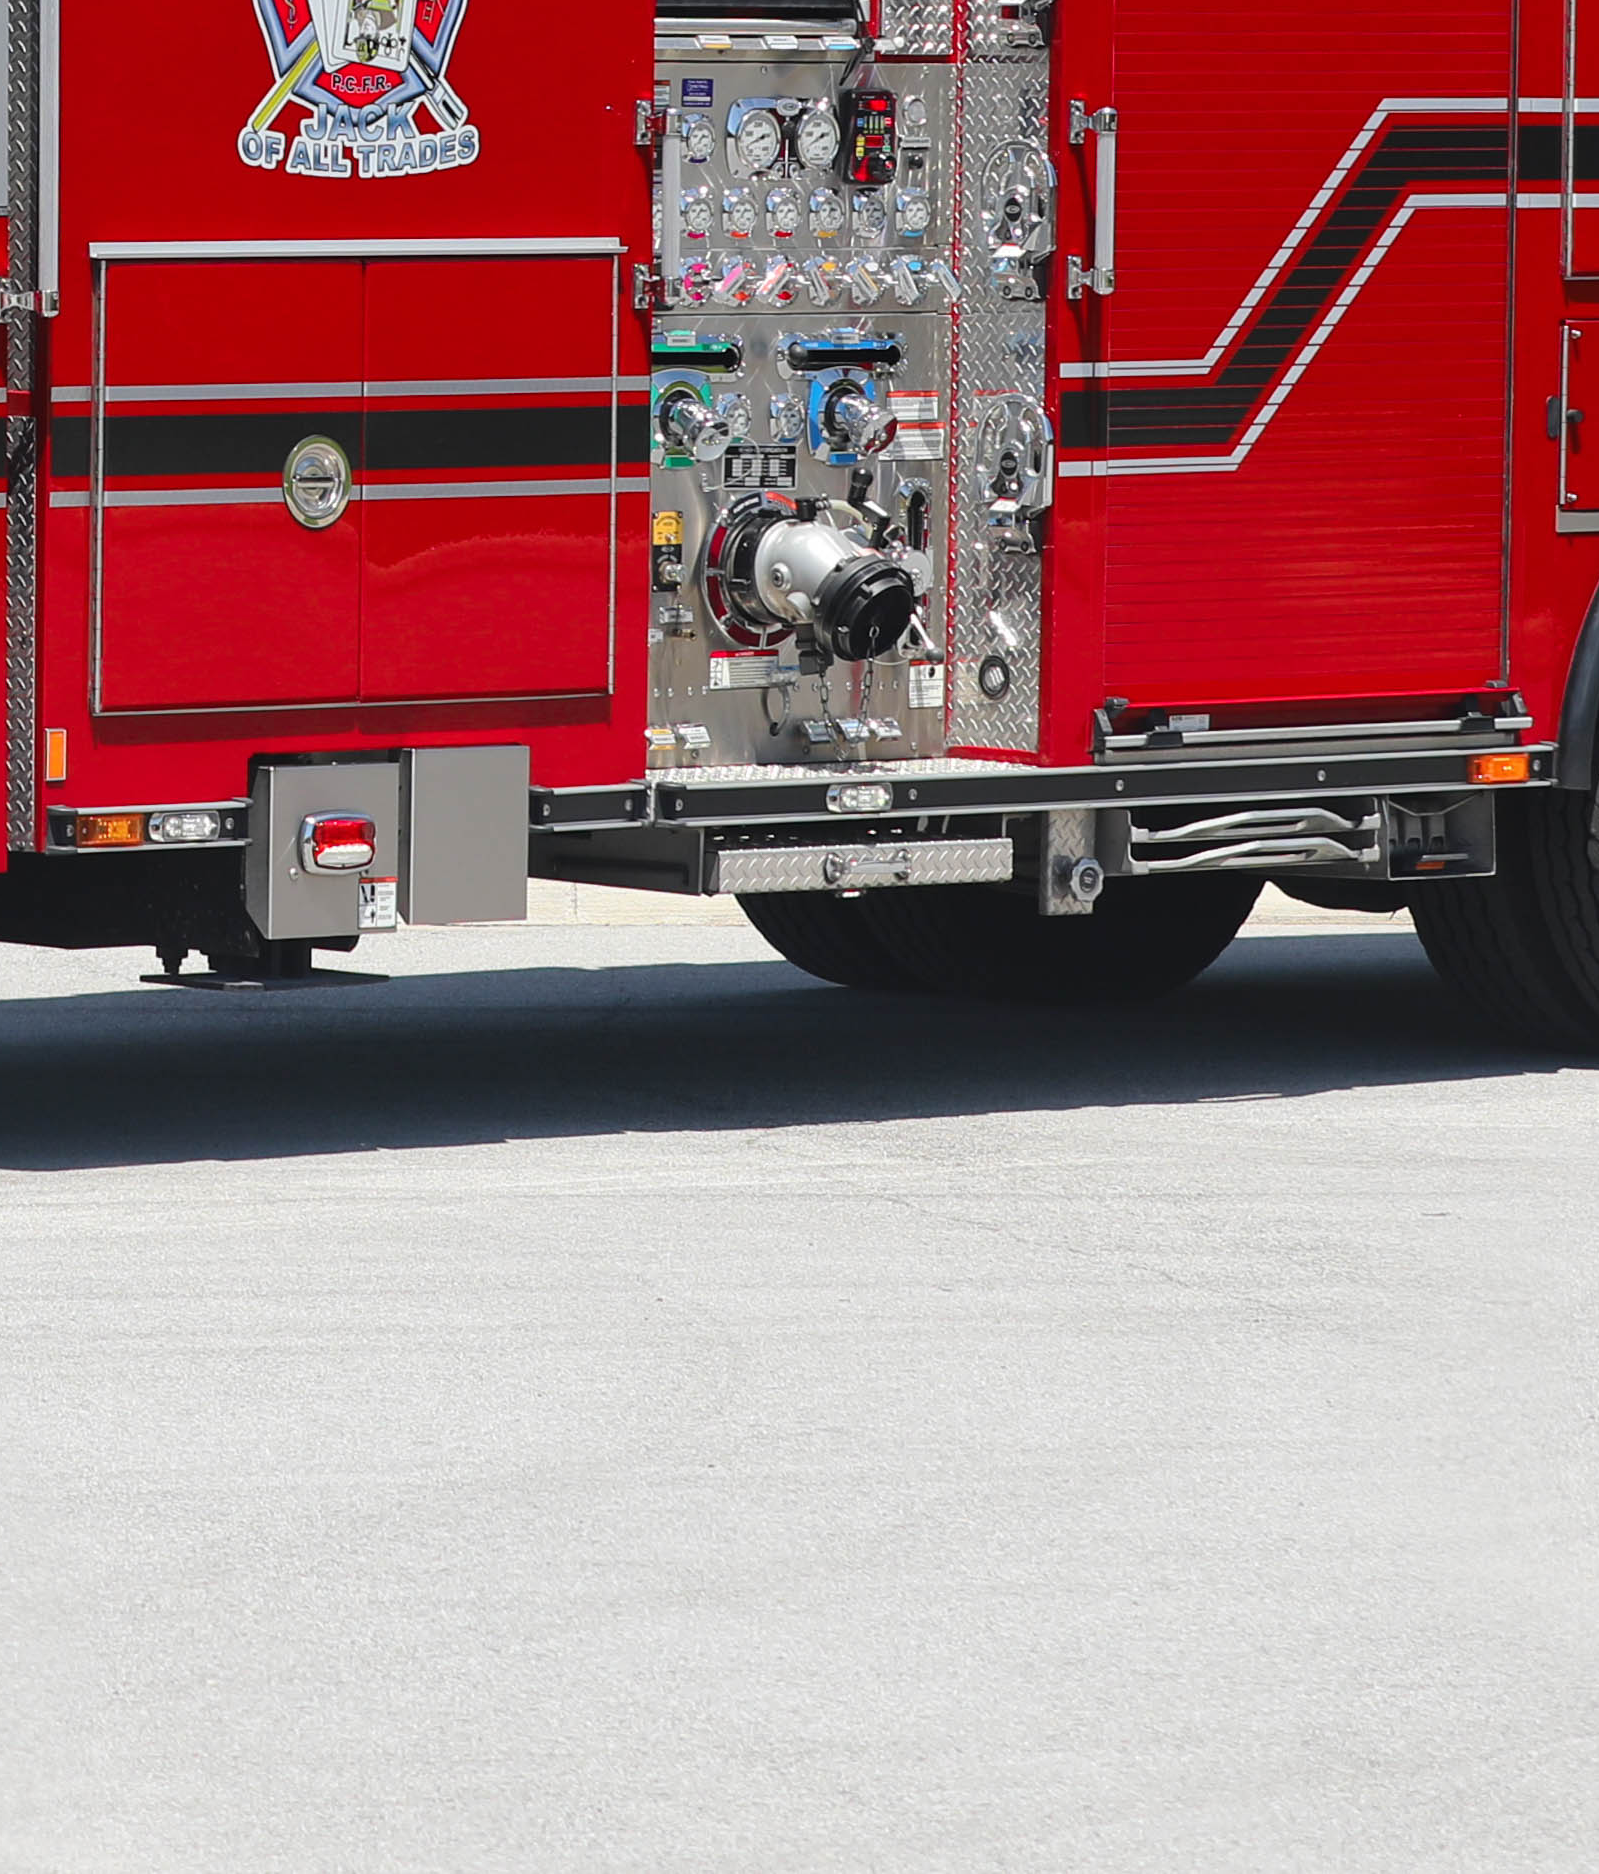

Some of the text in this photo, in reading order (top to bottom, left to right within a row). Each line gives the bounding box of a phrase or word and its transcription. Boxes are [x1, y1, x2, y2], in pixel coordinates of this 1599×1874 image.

[330, 73, 393, 93] P.C.F.R.
[304, 102, 417, 143] JACK
[241, 129, 477, 173] OF ALL TRADES
